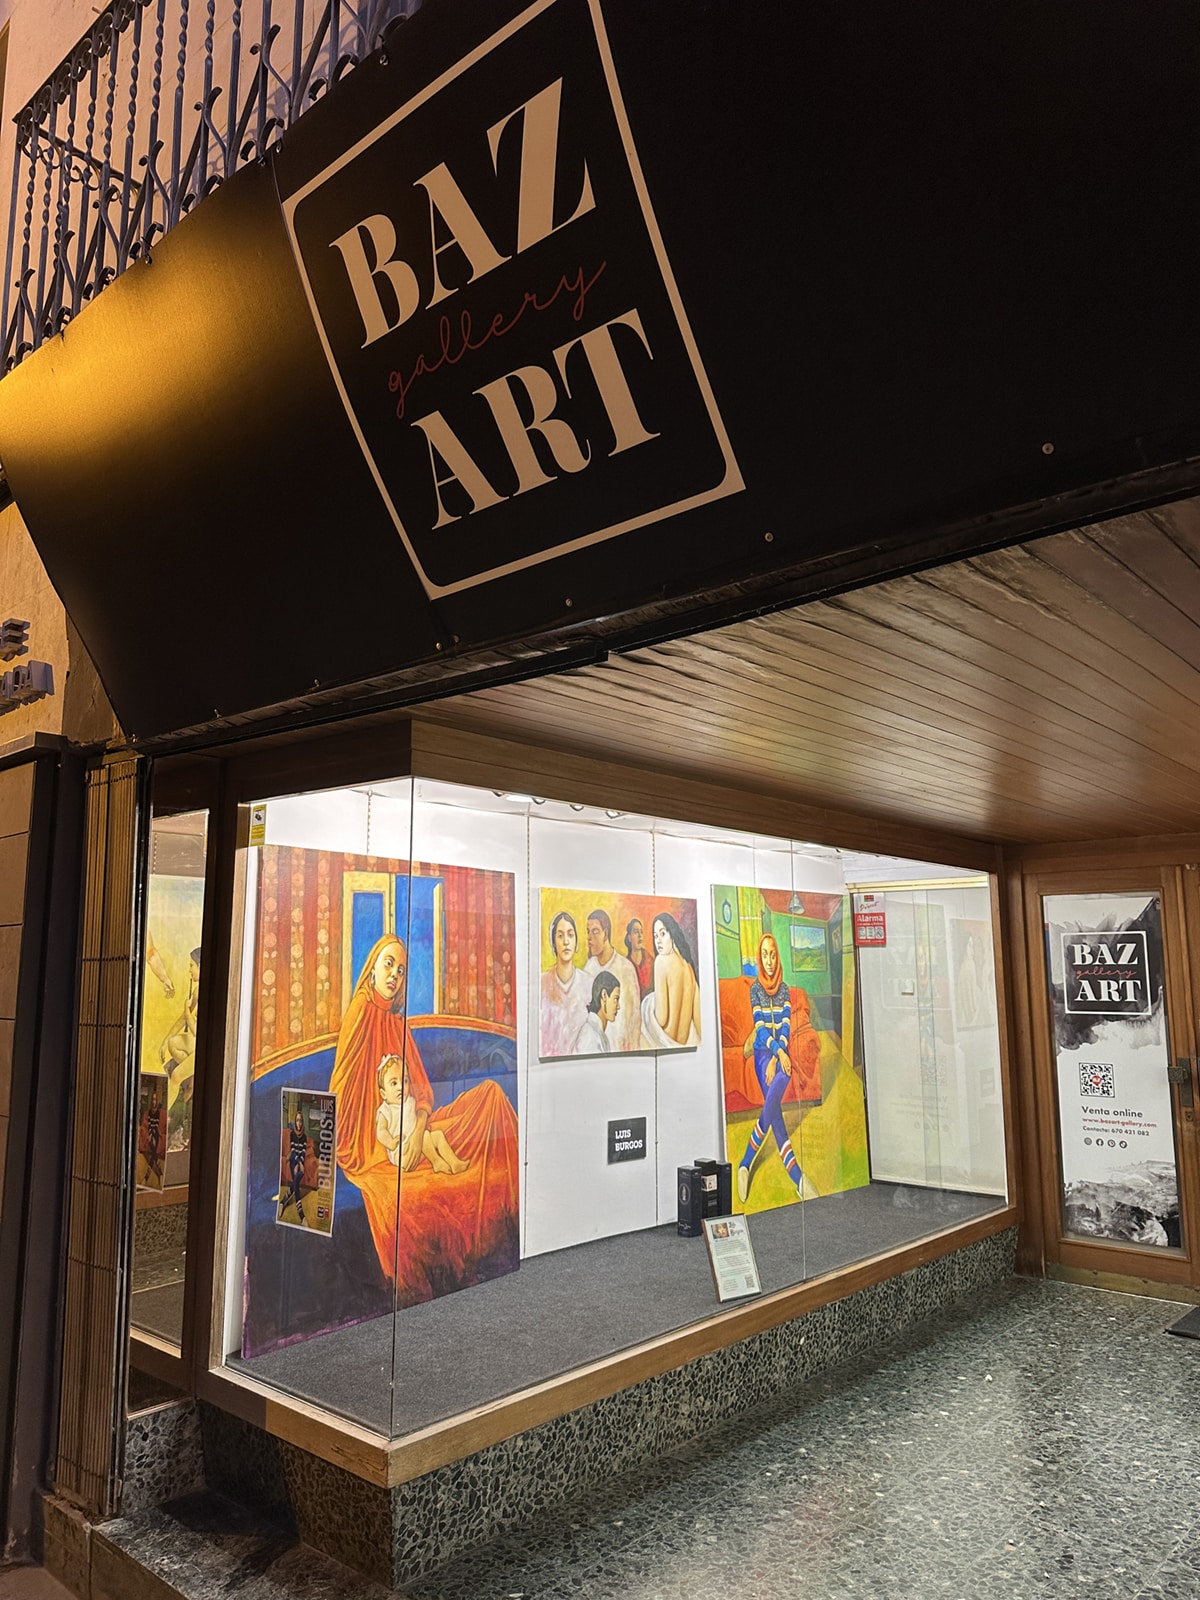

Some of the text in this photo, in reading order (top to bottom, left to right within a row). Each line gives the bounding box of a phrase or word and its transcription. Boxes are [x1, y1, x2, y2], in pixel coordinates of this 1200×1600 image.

[329, 76, 596, 349] BAZ
[387, 260, 606, 419] gallery
[410, 308, 661, 531] ART
[857, 914, 883, 922] Alarma
[1071, 943, 1138, 965] BAZ
[1076, 966, 1137, 979] gallery
[1074, 980, 1142, 1002] ART
[1081, 1105, 1143, 1118] Venta online
[615, 1129, 631, 1140] LUIS
[615, 1139, 643, 1151] BURGOS
[318, 1119, 334, 1189] BURGOS
